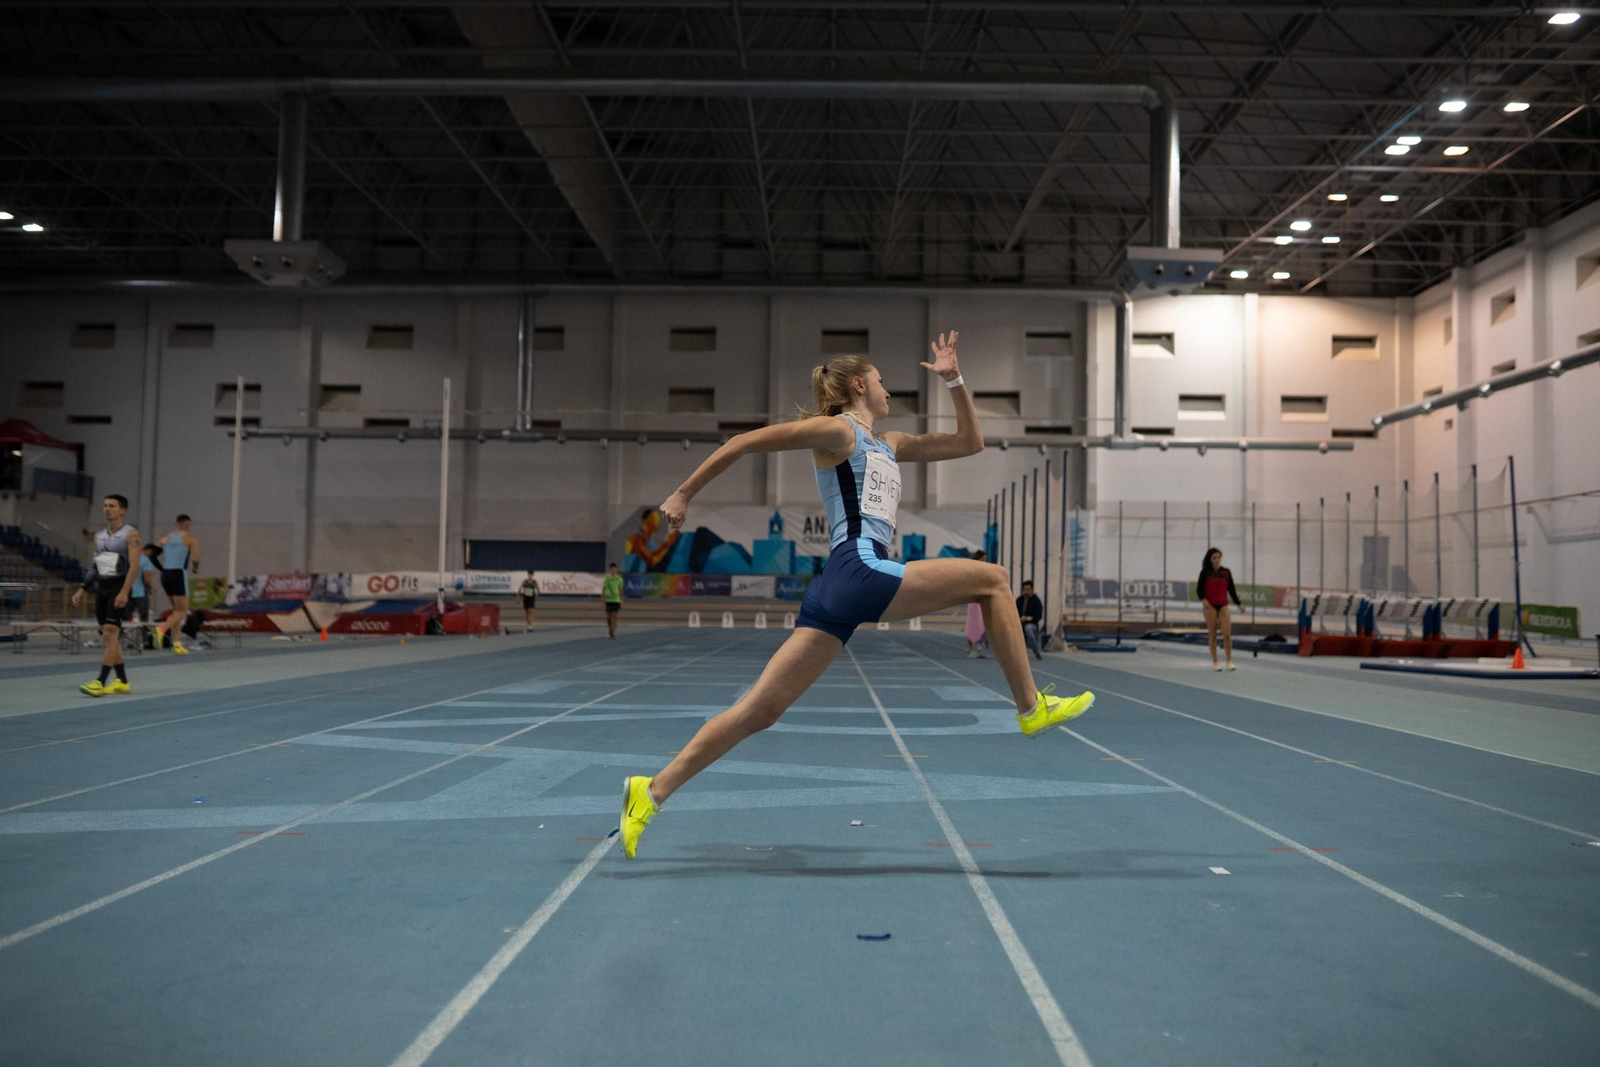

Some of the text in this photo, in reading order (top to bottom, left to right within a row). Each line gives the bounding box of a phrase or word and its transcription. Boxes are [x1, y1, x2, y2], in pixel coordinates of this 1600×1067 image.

[868, 493, 882, 504] 235
[367, 575, 419, 593] GO fit
